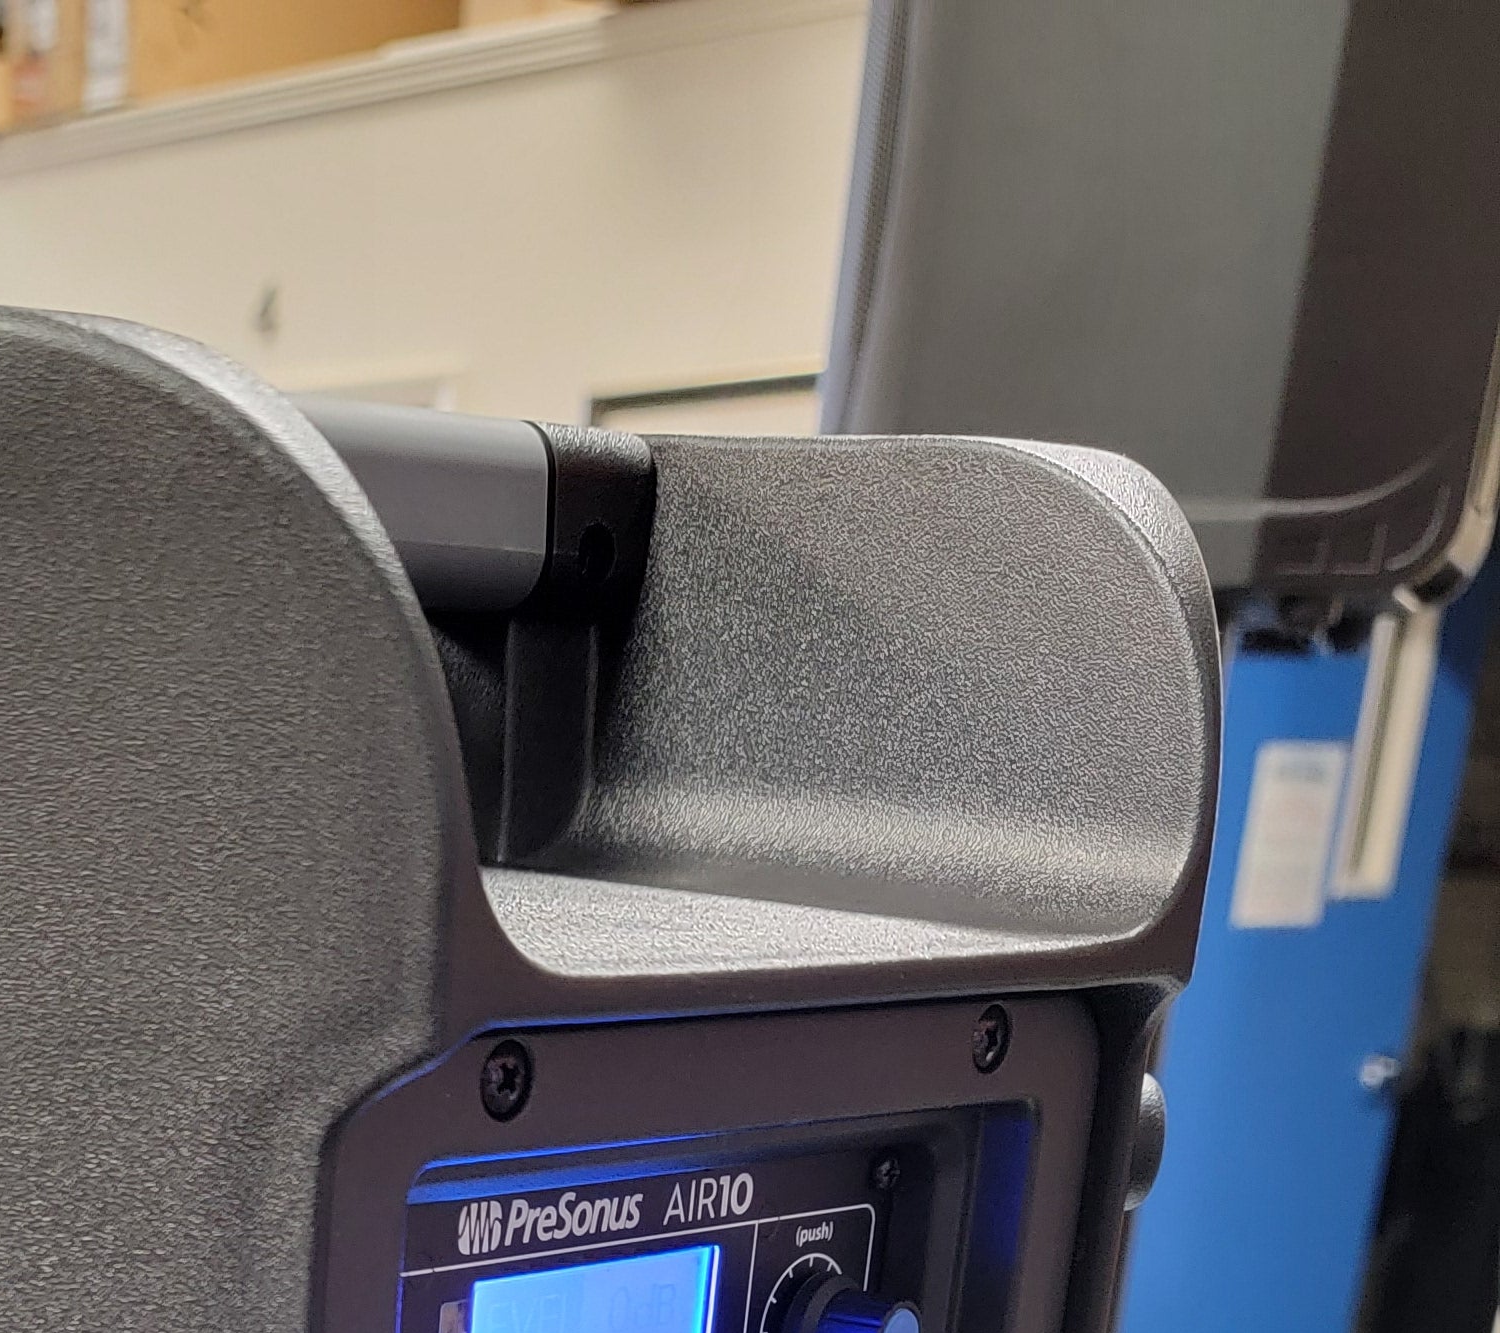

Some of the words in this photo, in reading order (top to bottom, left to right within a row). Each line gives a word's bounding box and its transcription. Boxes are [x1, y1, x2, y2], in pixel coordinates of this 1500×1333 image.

[504, 1191, 644, 1247] PreSonus
[662, 1172, 755, 1226] AIR10
[795, 1220, 834, 1247] (push)
